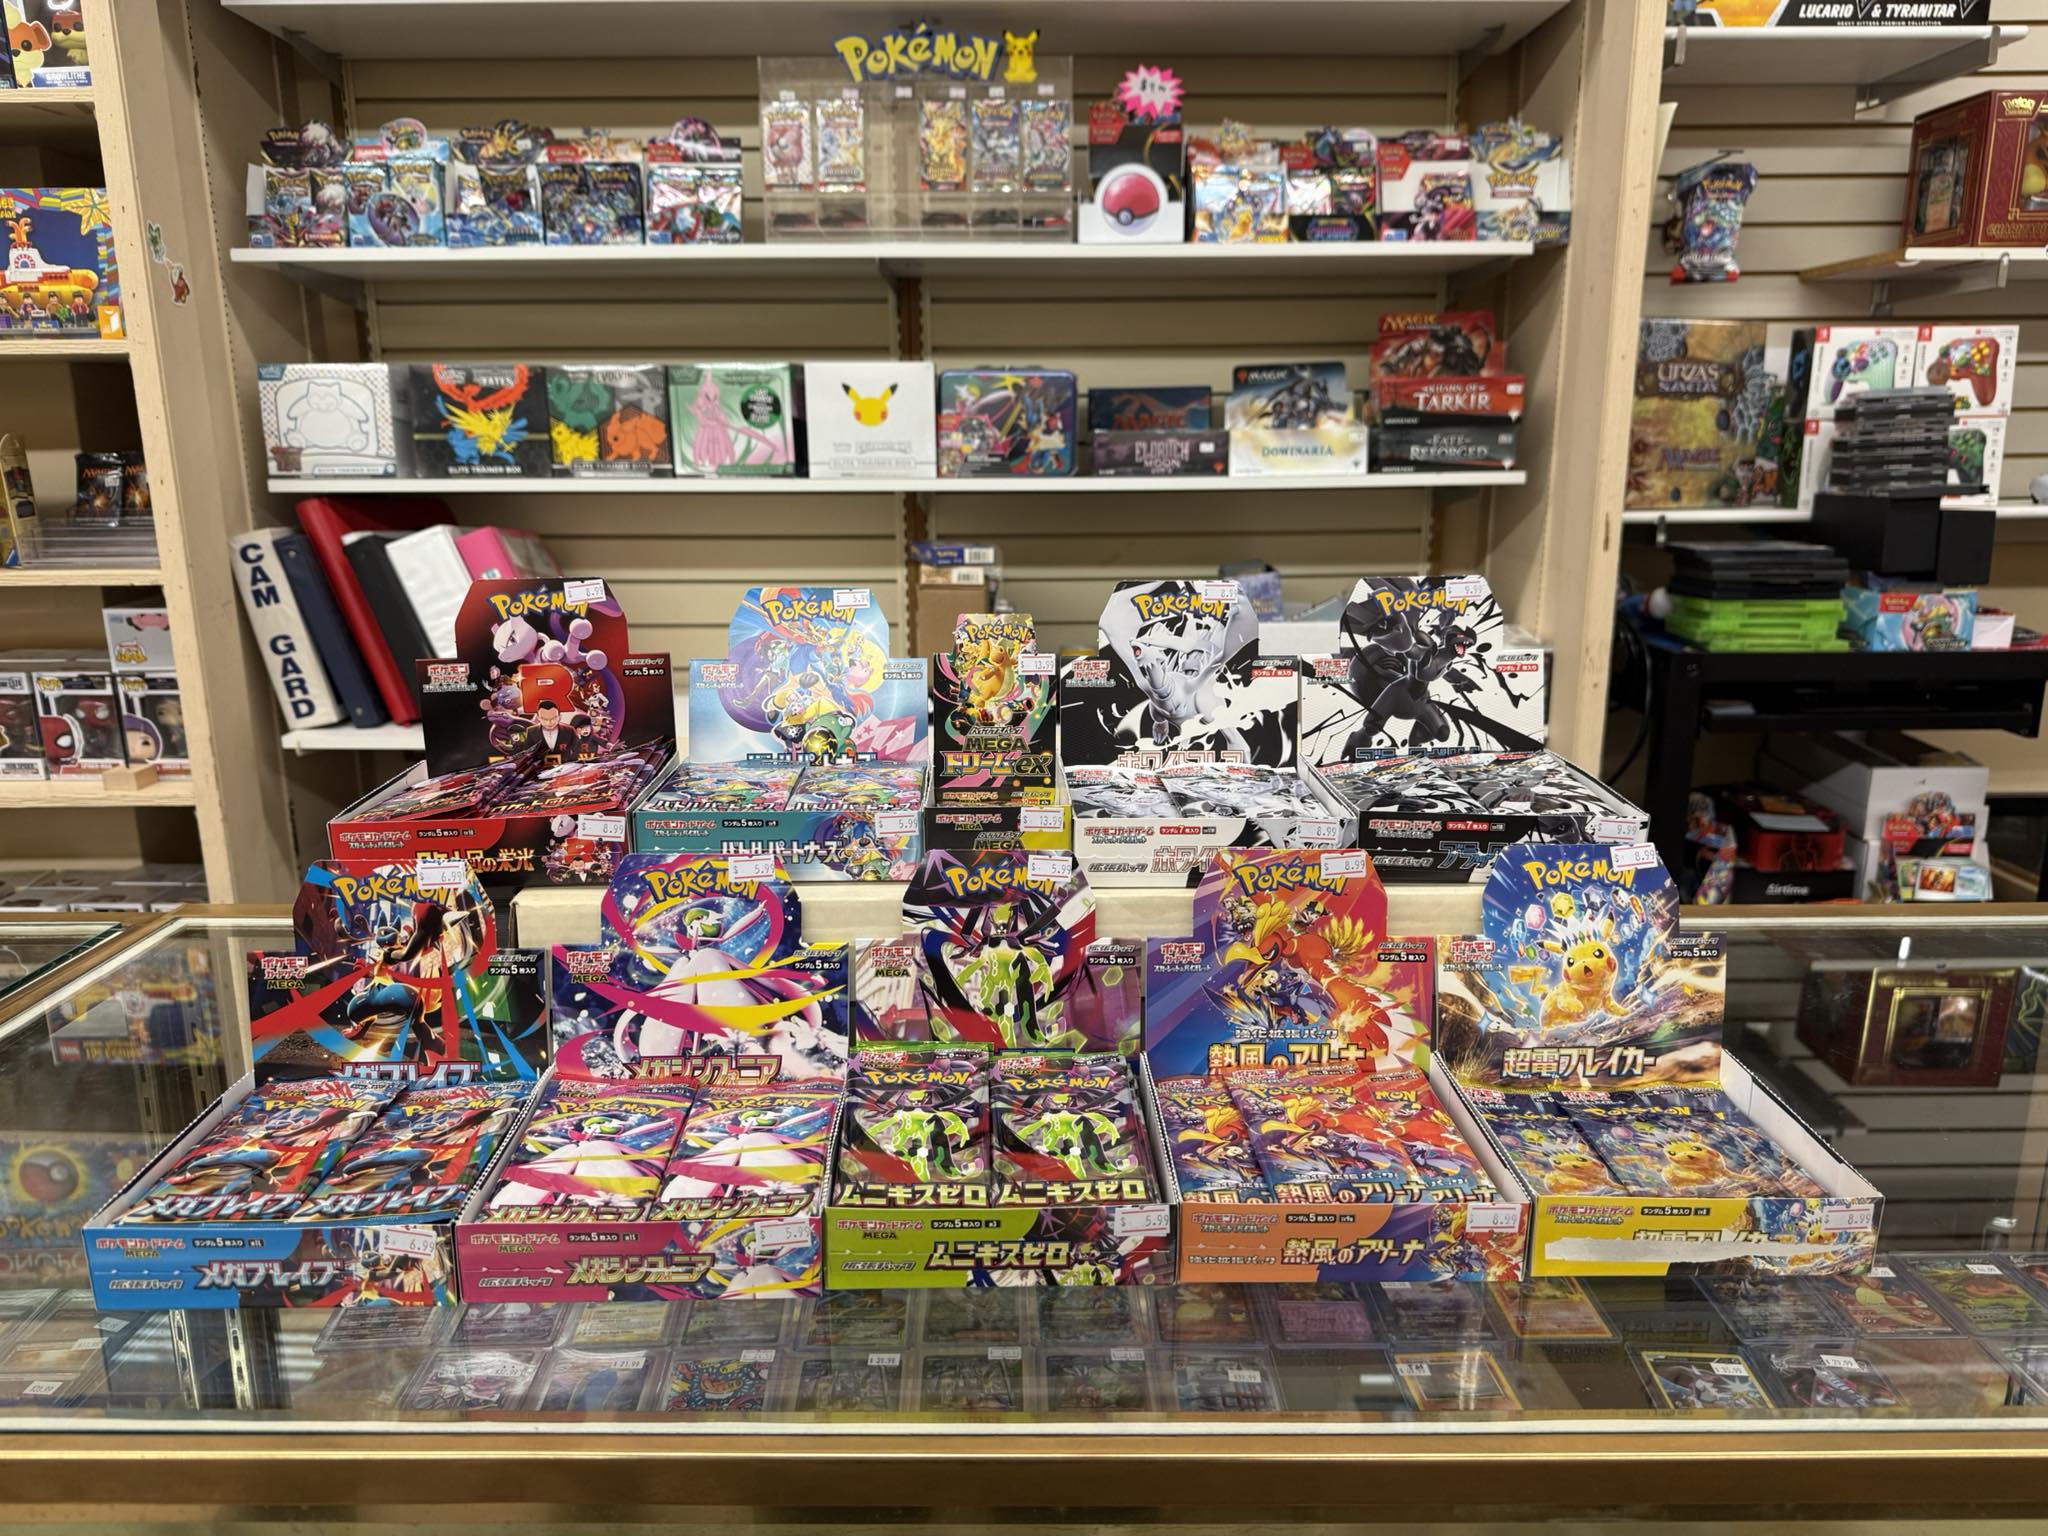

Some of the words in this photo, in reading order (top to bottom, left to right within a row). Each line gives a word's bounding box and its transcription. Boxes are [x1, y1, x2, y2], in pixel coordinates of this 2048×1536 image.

[1799, 4, 1854, 19] LUCARIO
[1871, 4, 1882, 19] &
[1886, 4, 1957, 19] TYRANITAR
[1412, 391, 1491, 412] TARKIR
[1261, 446, 1334, 457] DOMINARIA
[239, 543, 281, 609] CAM
[427, 662, 470, 677] ポケモン
[1072, 660, 1111, 671] ポケモン
[1313, 658, 1351, 669] ポケモン
[963, 735, 1030, 752] MEGA
[955, 823, 983, 832] MEGA
[973, 839, 1025, 850] MEGA
[871, 945, 914, 958] ポケモン
[1160, 942, 1206, 955] ポケモン
[1450, 940, 1496, 953] ポケモン
[261, 956, 309, 969] ポケモン
[566, 951, 614, 963] ポケモン
[872, 957, 912, 968] カードゲーム
[1163, 954, 1202, 965] カードゲーム
[1453, 952, 1492, 963] カードゲーム
[264, 968, 306, 980] カードゲーム
[568, 962, 611, 974] カードゲーム
[874, 968, 911, 978] MEGA
[267, 979, 305, 990] MEGA
[571, 973, 609, 985] MEGA
[1502, 1046, 1657, 1078] 超電ブレイカー
[838, 1182, 990, 1207] ムニキスゼロ
[998, 1178, 1149, 1205] ムニキスゼロ
[862, 1230, 898, 1241] MEGA
[124, 1249, 161, 1259] MEGA
[497, 1244, 534, 1254] MEGA
[1280, 1236, 1428, 1266] 熱風のアリーナ
[924, 1241, 1073, 1271] ムニキスゼロ
[193, 1261, 341, 1291] メガブレイブ
[564, 1253, 716, 1287] メガシンフォニア
